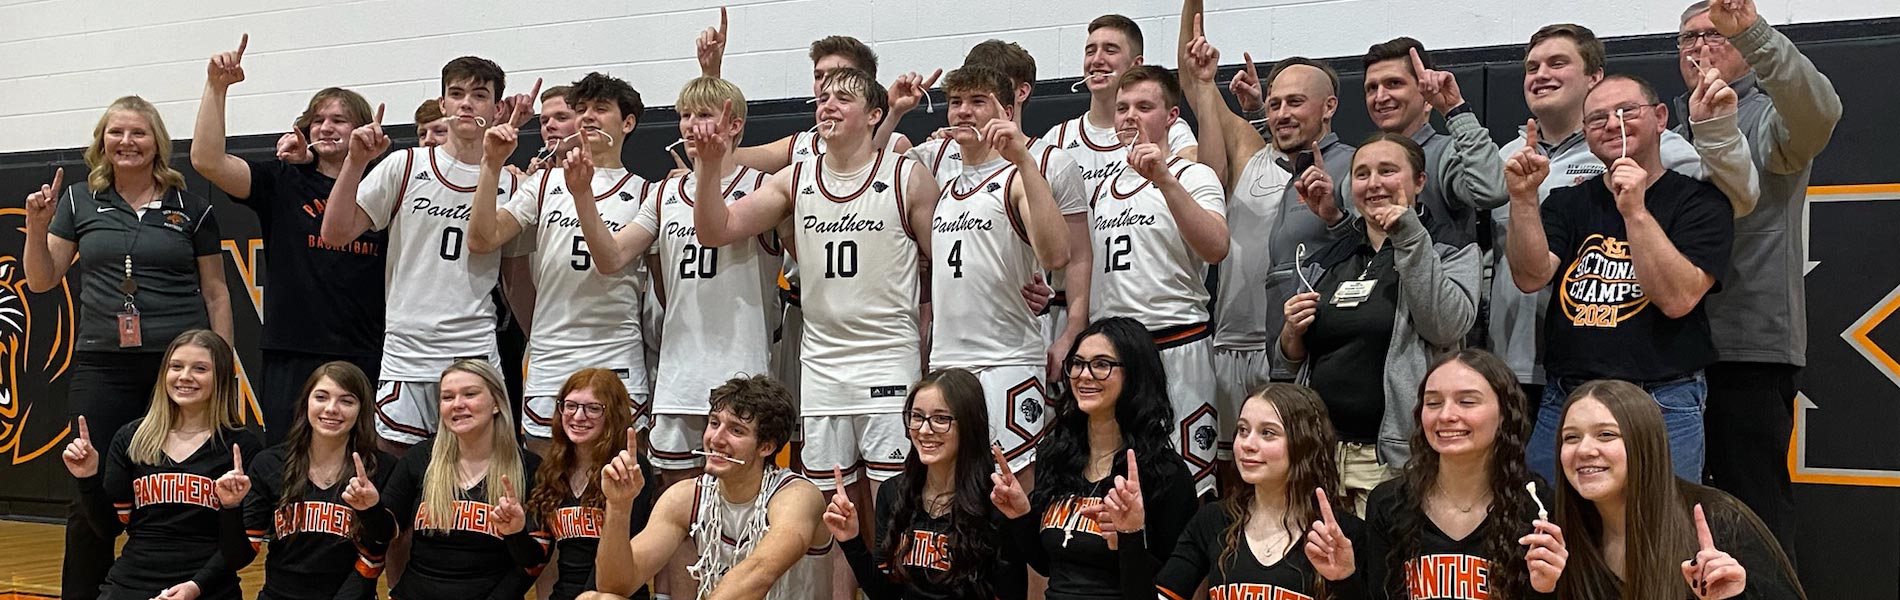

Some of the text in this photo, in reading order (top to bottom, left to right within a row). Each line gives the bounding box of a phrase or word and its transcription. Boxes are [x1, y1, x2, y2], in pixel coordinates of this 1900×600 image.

[413, 197, 470, 220] Panth
[803, 213, 885, 233] Panthers
[932, 211, 993, 233] Panthers
[1095, 207, 1156, 231] Panthers
[440, 227, 463, 261] 0
[571, 235, 591, 271] 5
[824, 240, 858, 279] 10
[947, 240, 963, 279] 4
[1104, 234, 1132, 274] 12
[680, 244, 718, 279] 20
[1569, 279, 1644, 303] CHAMPS
[1573, 303, 1619, 328] 2021
[132, 472, 221, 511] PANTHERS
[1404, 553, 1490, 600] PANTHE
